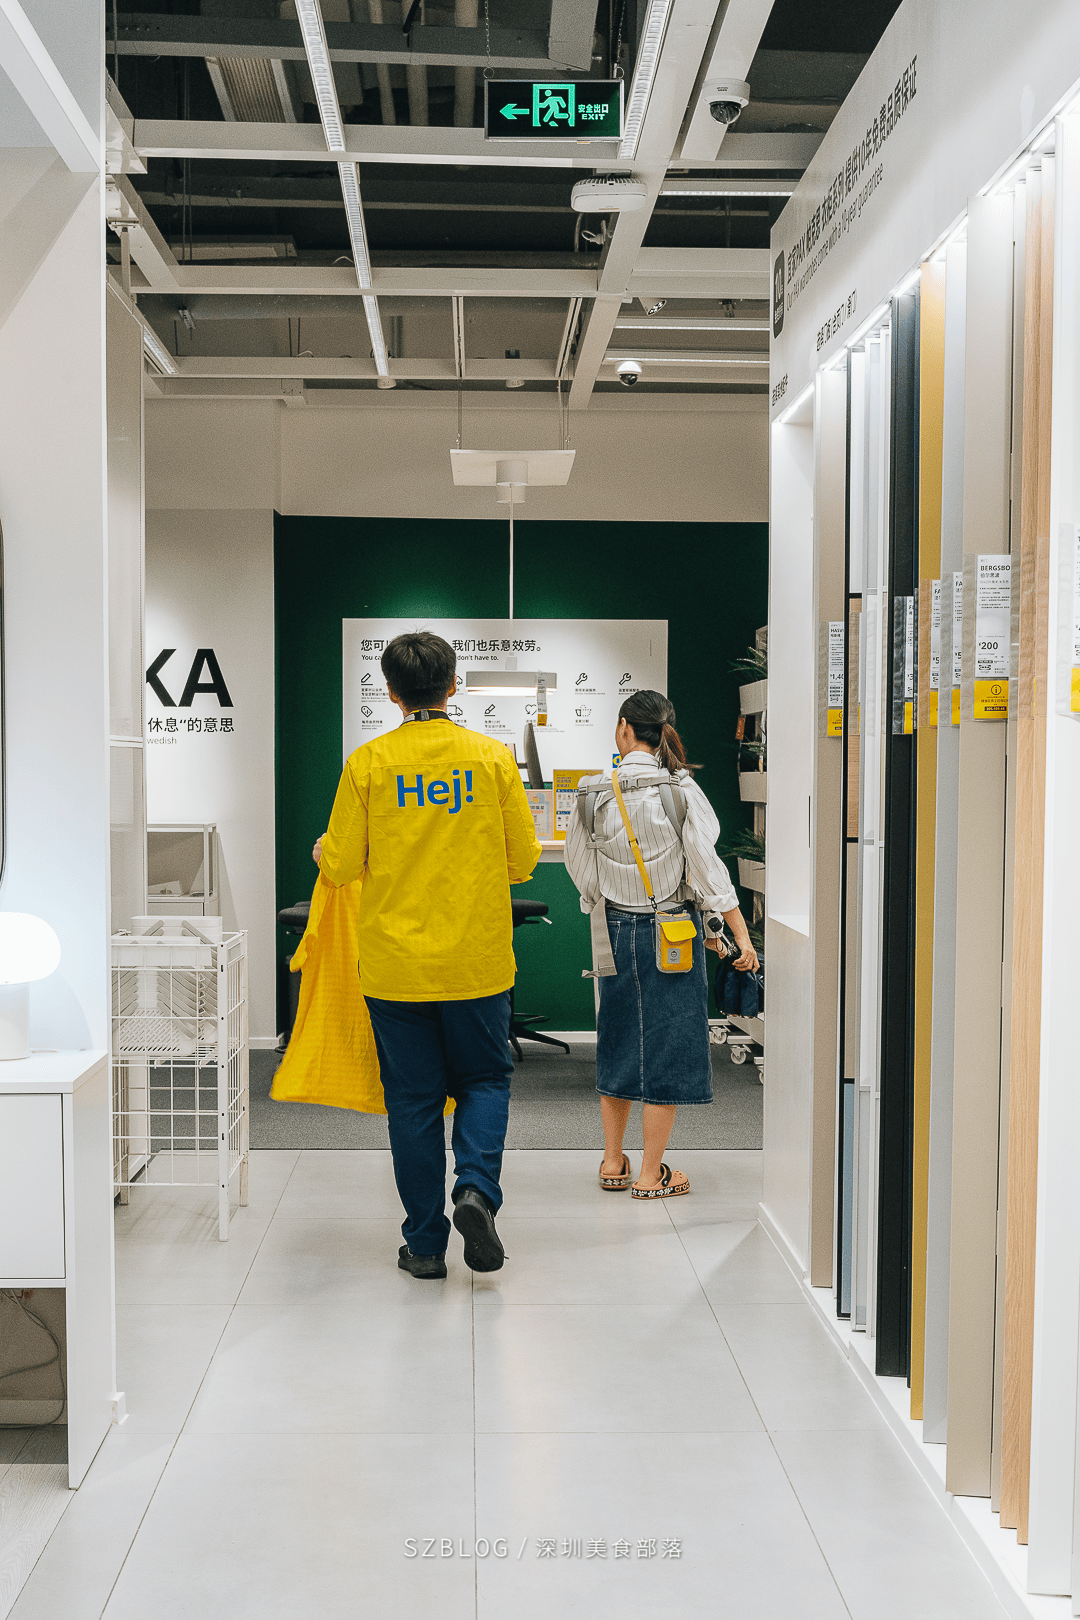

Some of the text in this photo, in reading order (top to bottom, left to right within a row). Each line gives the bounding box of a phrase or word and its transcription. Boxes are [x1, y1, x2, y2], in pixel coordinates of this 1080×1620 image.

[578, 103, 609, 114] 安全出口
[452, 639, 541, 652] 我们也乐意效劳。
[396, 769, 474, 815] Hej!
